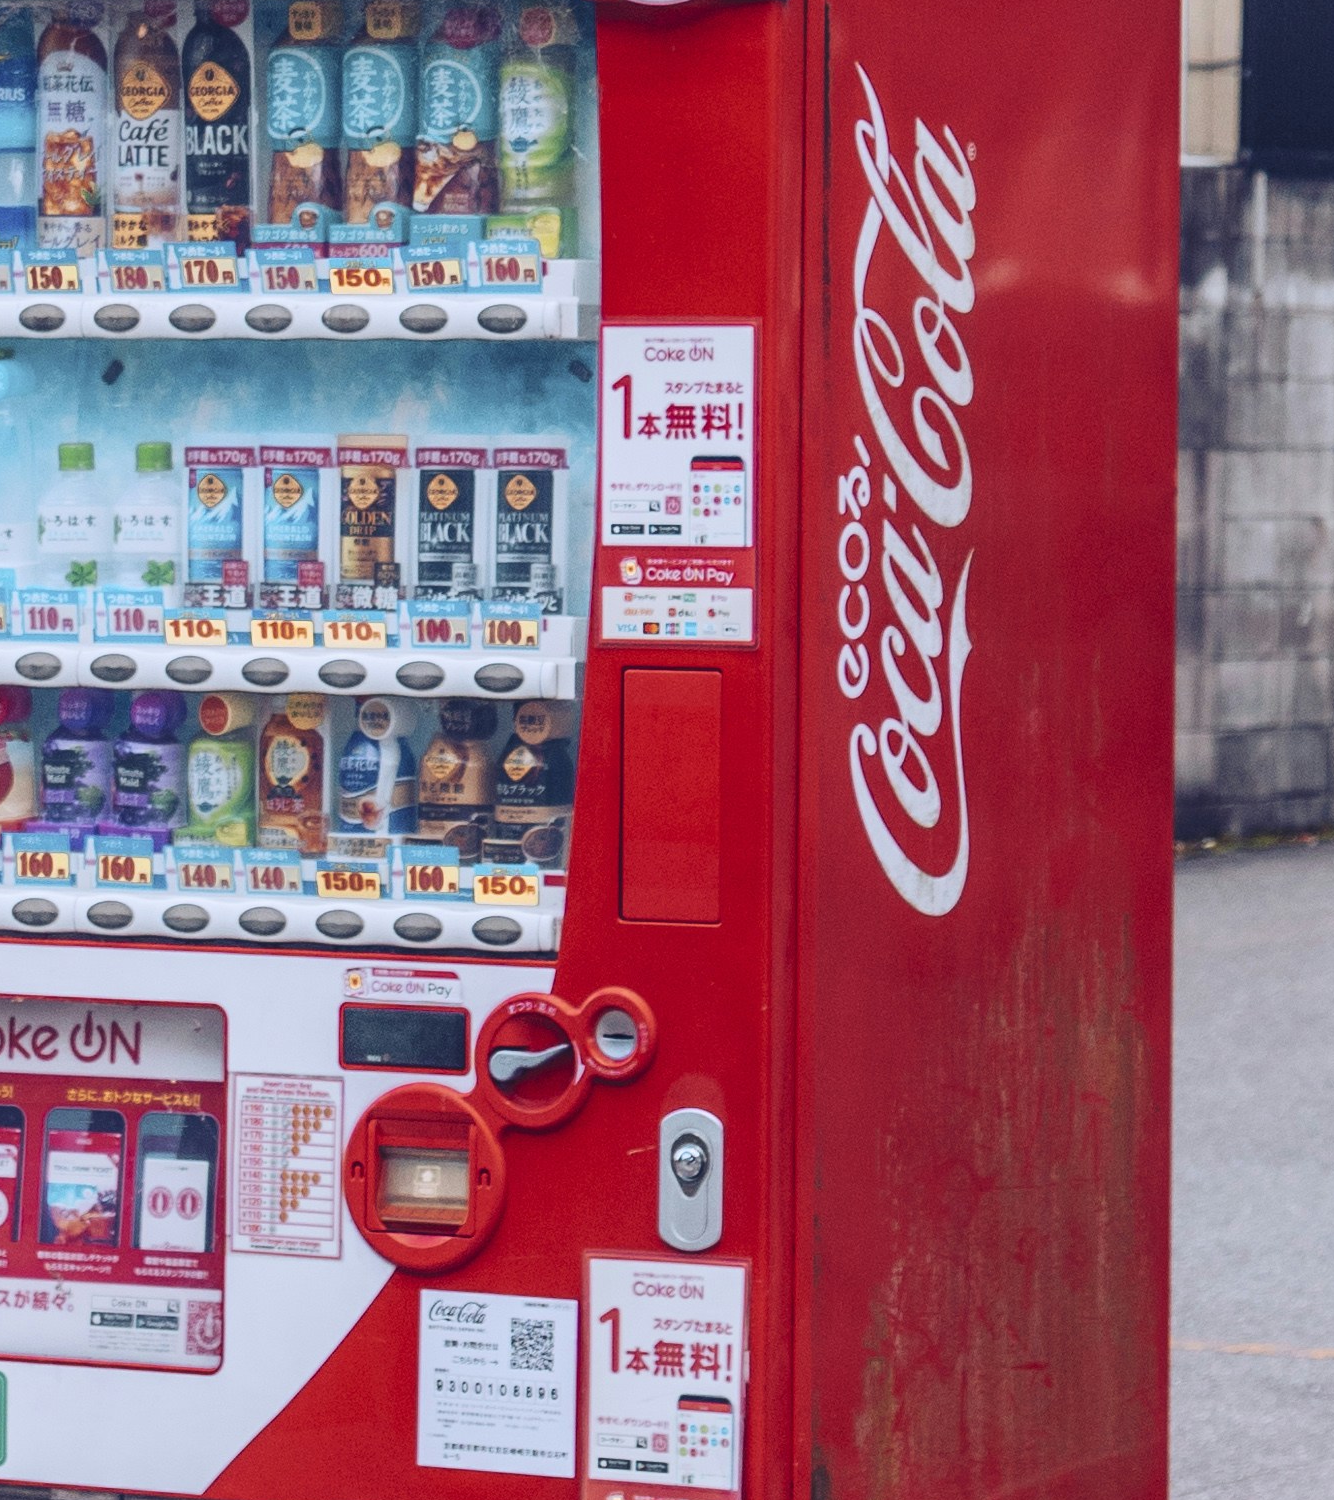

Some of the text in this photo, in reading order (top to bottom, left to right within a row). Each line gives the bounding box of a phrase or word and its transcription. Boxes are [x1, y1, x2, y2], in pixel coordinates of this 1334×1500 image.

[122, 86, 166, 97] GEORGIA
[190, 86, 235, 97] GEORGIA
[272, 58, 302, 131] 麦茶
[349, 56, 381, 128] 麦茶
[429, 69, 456, 128] 麦茶
[47, 101, 86, 122] 無糖
[118, 119, 170, 144] Café
[186, 124, 248, 156] BLACK
[118, 145, 169, 168] LATTE
[644, 345, 715, 362] Coke ON
[664, 382, 744, 395] スタンプたまると
[850, 59, 979, 919] Coca-Cola
[344, 511, 392, 526] GOLDEN
[420, 522, 470, 543] BLACK
[498, 522, 549, 543] BLACK
[645, 566, 735, 586] Coke ON Pay
[203, 585, 246, 608] 王道
[278, 585, 323, 609] 王道
[352, 585, 399, 610] 微糖
[372, 980, 453, 999] Coke ON Pay
[69, 1010, 143, 1066] ON
[633, 1281, 705, 1300] Coke ON
[429, 1299, 489, 1325] Coca-Cola
[653, 1318, 733, 1336] スタンプたまると
